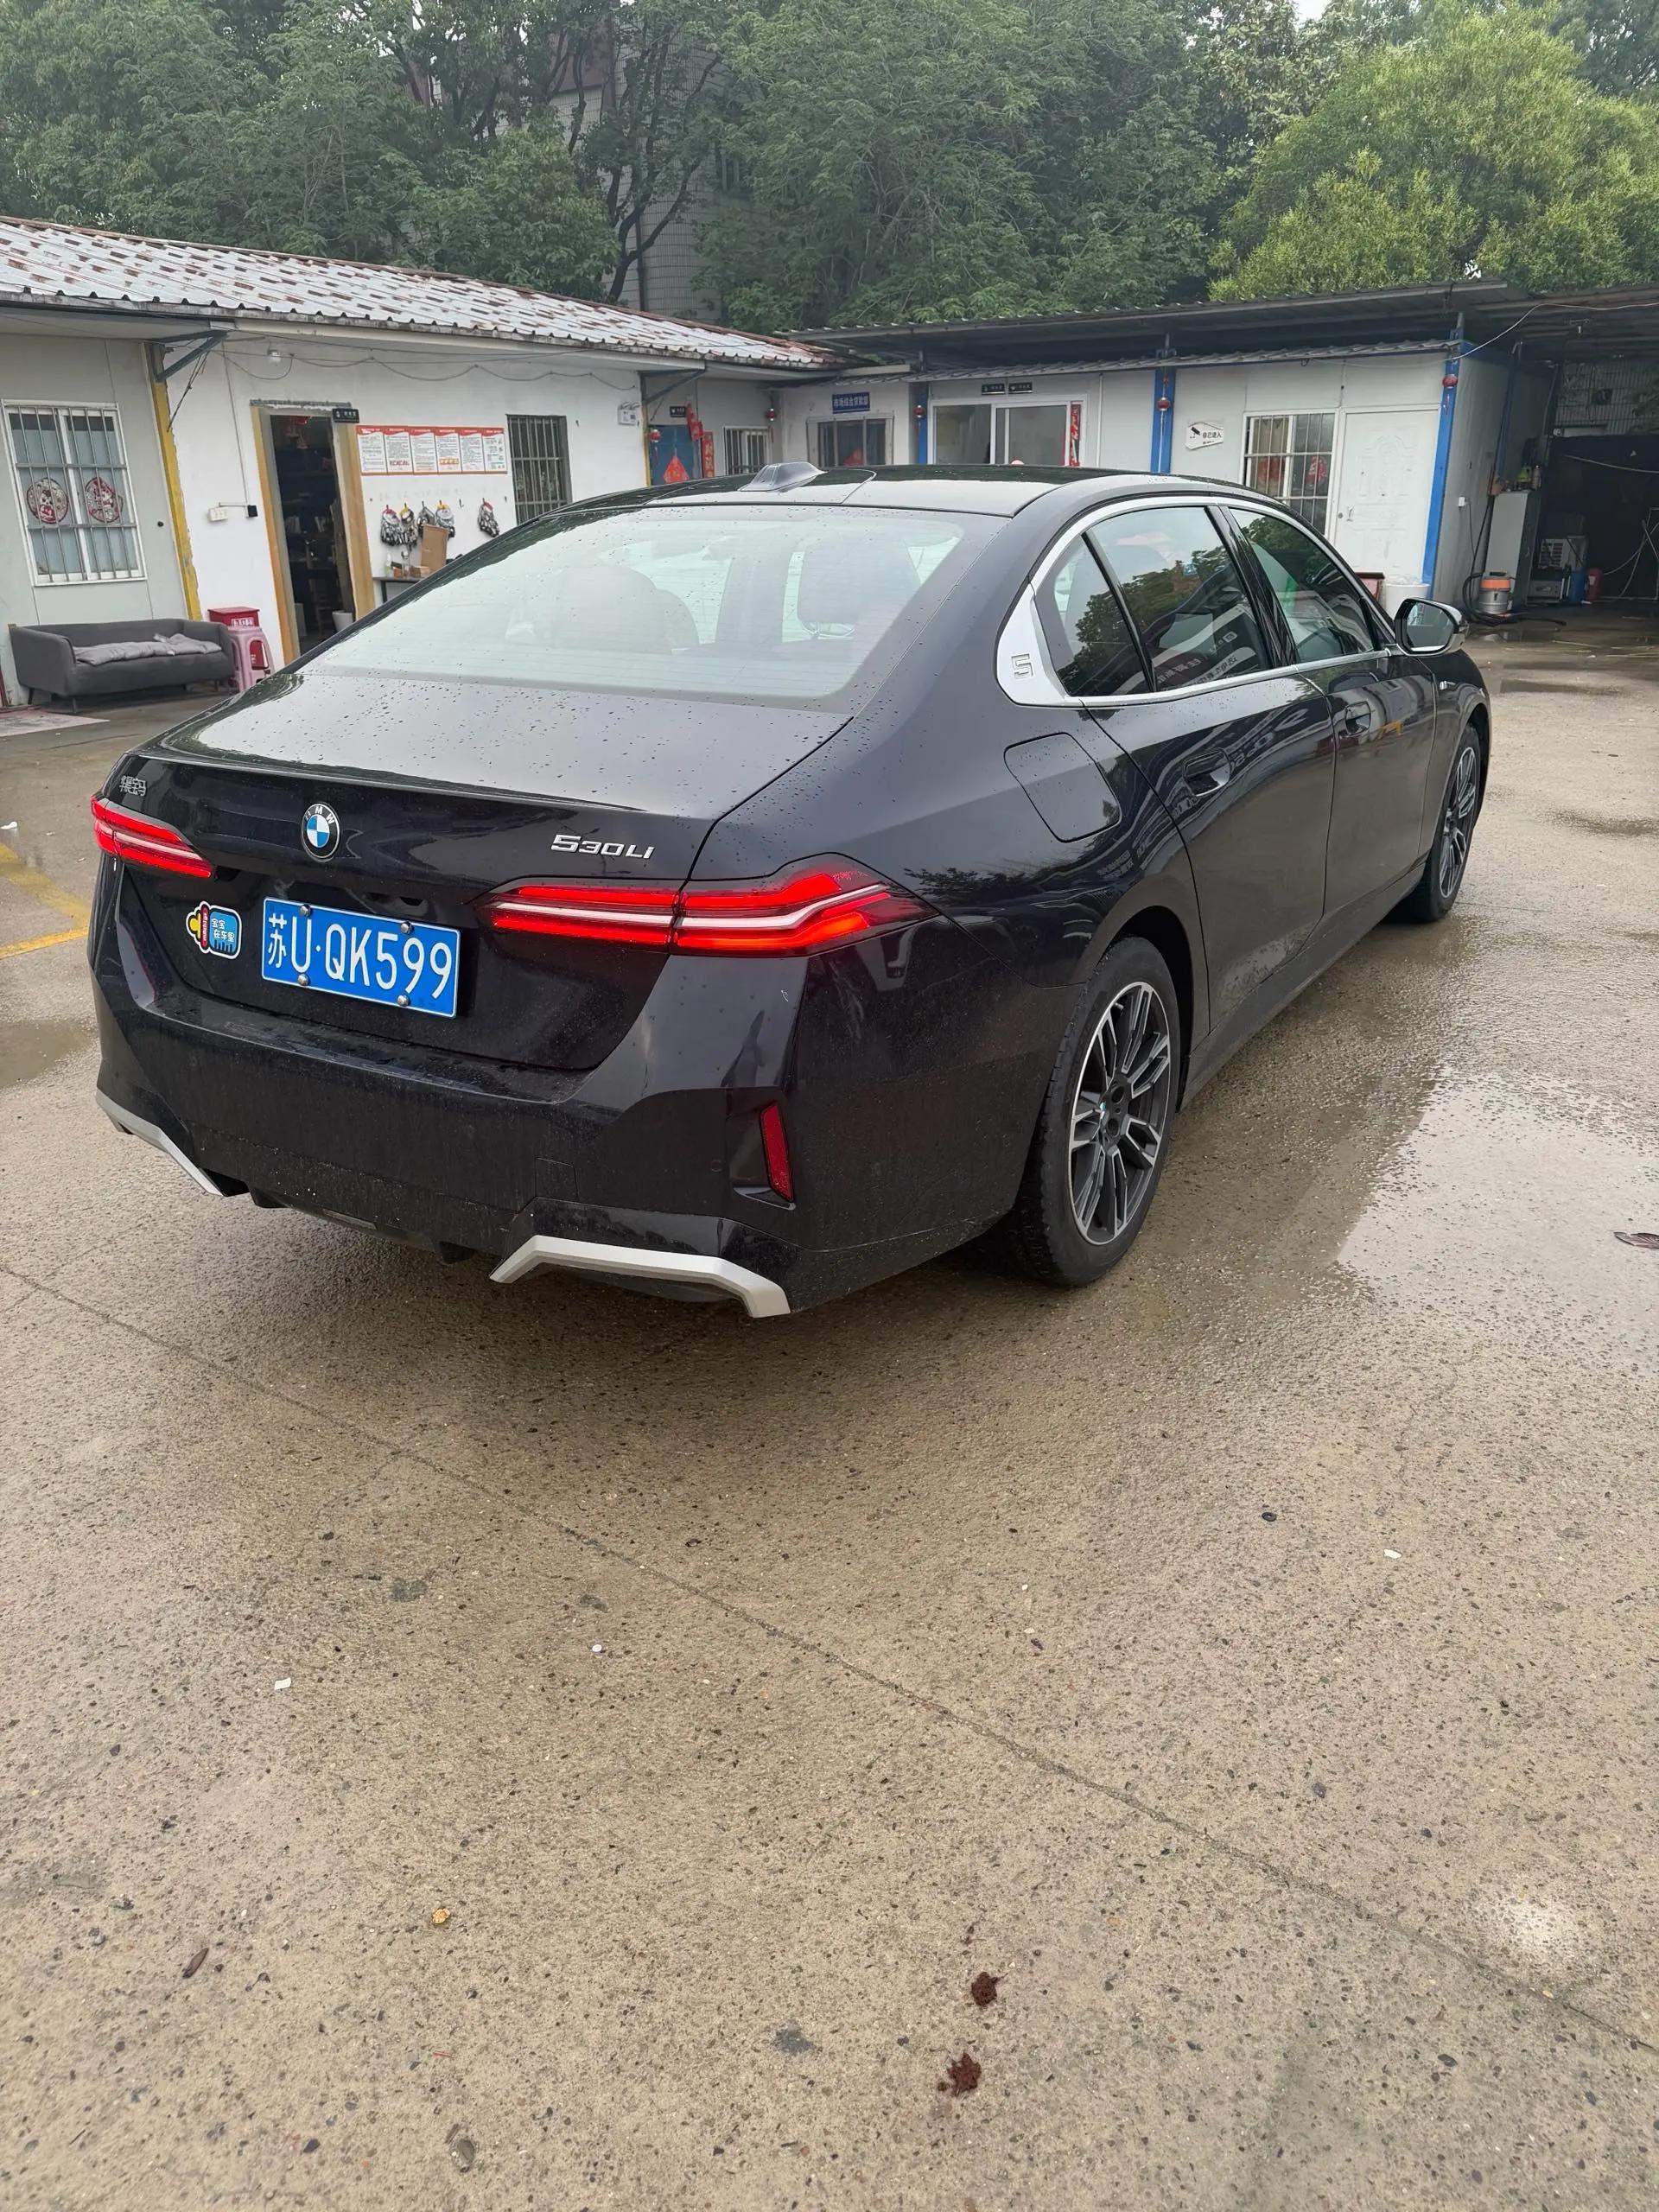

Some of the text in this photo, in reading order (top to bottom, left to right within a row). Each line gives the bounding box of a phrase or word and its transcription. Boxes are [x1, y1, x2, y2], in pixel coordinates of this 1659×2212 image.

[211, 918, 226, 930] 宝宝
[213, 929, 235, 943] 在车里
